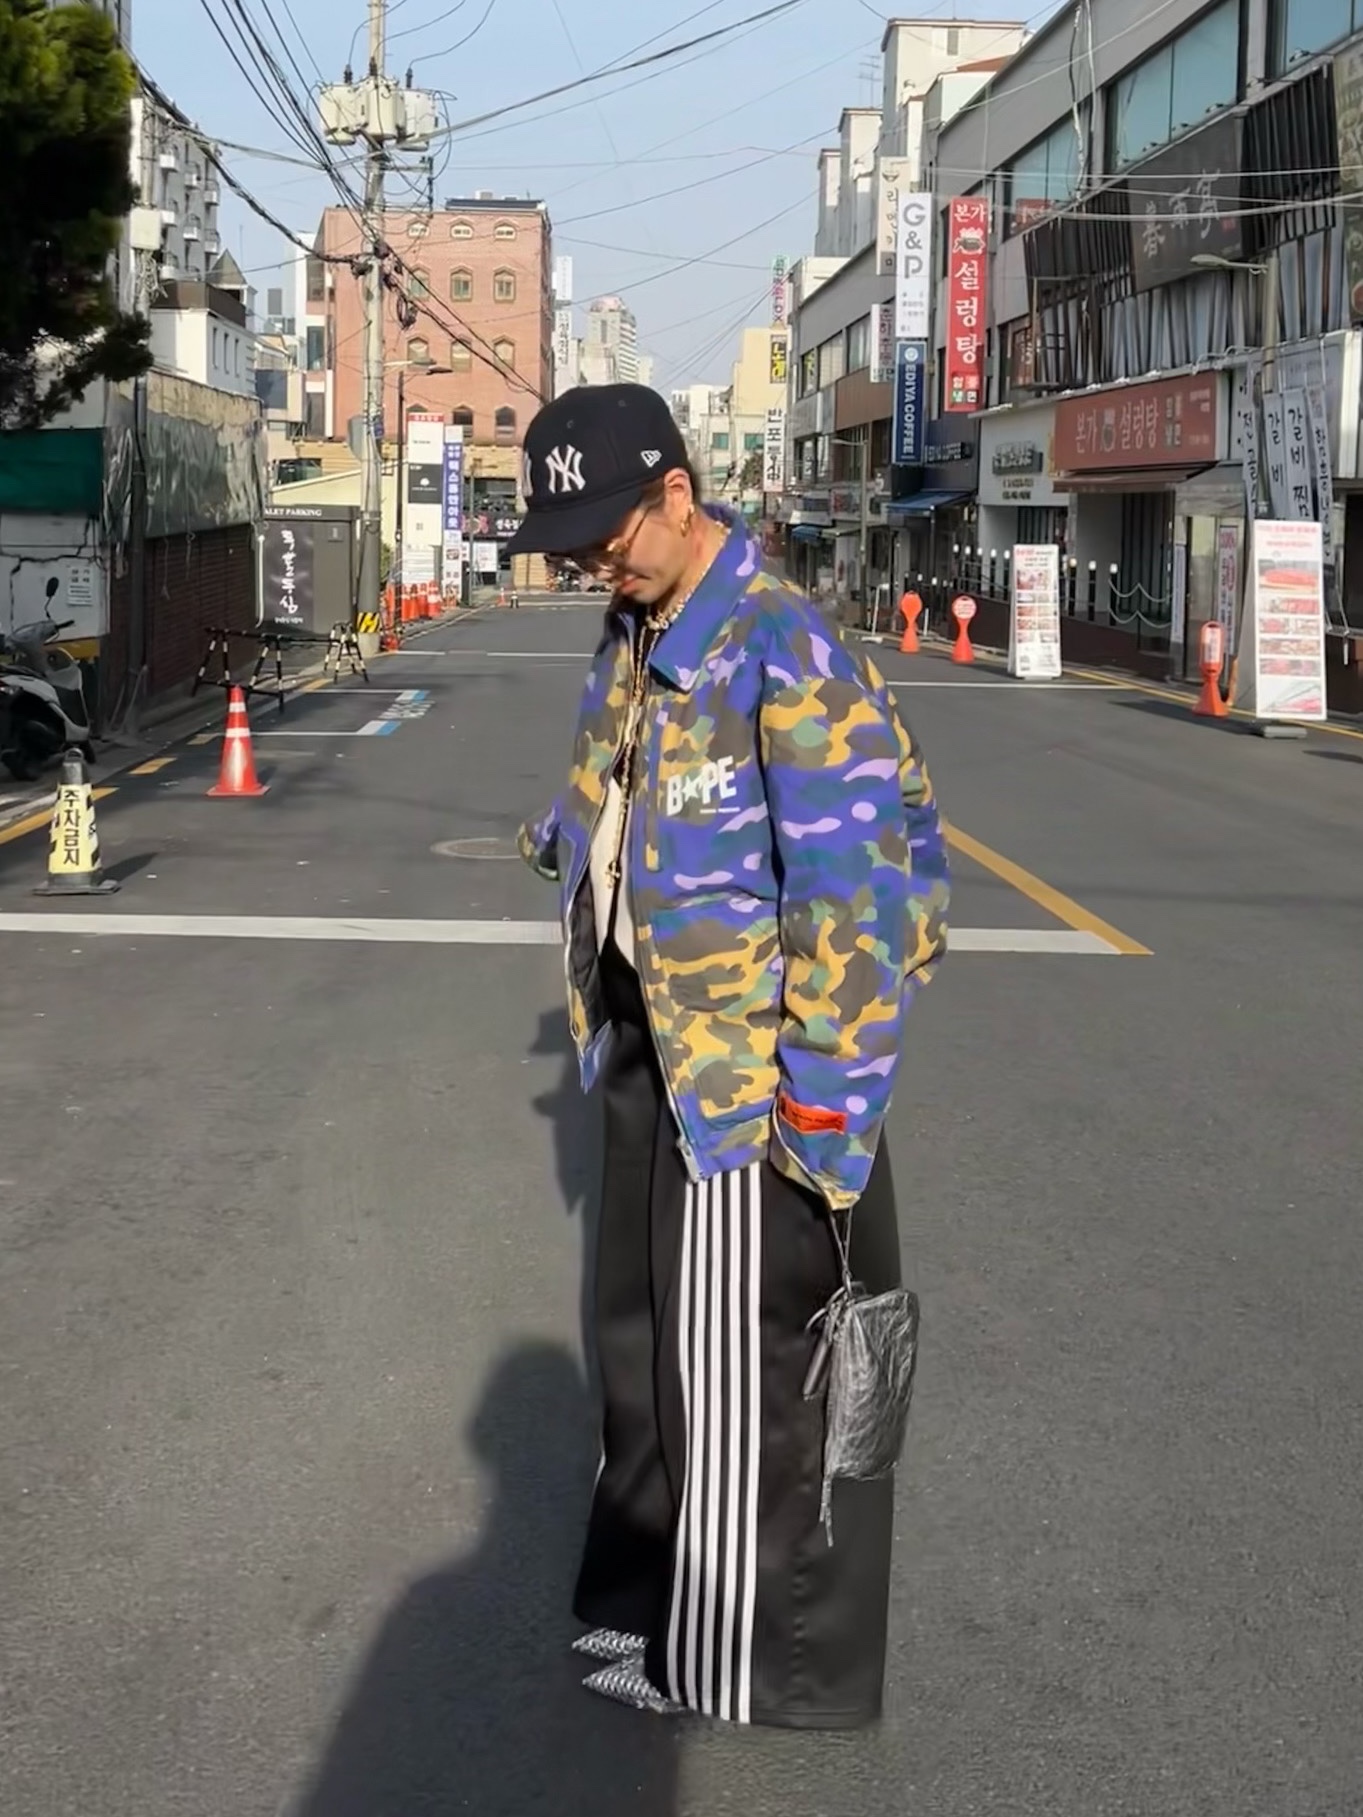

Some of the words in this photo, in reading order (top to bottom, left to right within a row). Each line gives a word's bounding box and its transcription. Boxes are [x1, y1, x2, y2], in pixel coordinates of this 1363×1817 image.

[954, 203, 986, 223] 본가
[903, 203, 926, 279] G&P
[954, 260, 982, 365] 설렁탕
[904, 363, 917, 403] EDIYA
[903, 405, 915, 454] COFFEE
[1075, 410, 1098, 454] 본가
[1119, 400, 1159, 450] 설렁탕
[545, 444, 586, 494] NY
[1288, 405, 1310, 518] 갈비찜
[286, 508, 322, 516] PARKING
[63, 789, 82, 866] 주차금지
